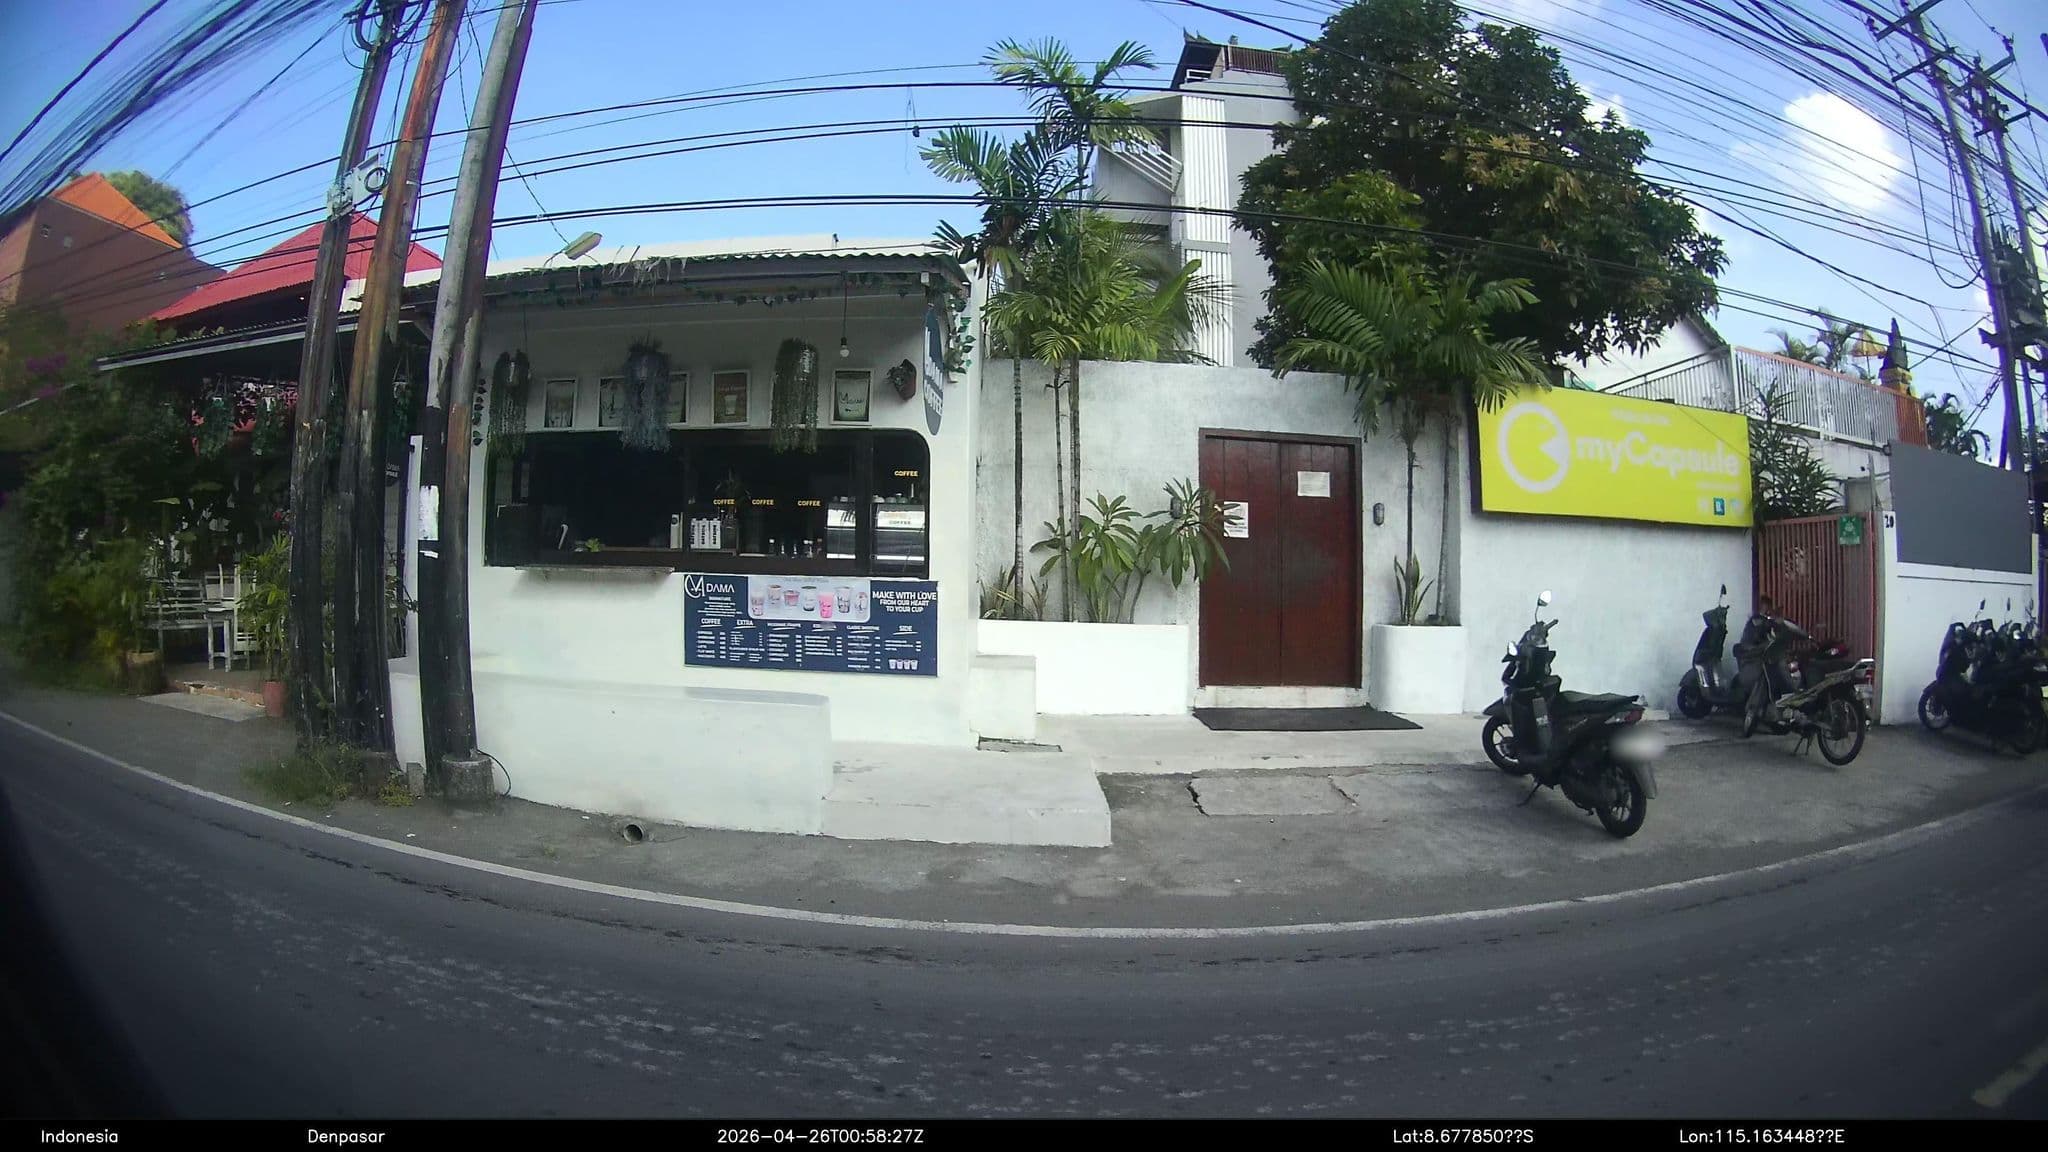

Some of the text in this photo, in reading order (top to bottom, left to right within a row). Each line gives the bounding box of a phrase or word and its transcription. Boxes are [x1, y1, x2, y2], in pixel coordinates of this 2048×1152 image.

[1575, 431, 1740, 478] myCapsule
[1883, 515, 1895, 528] 20
[706, 583, 735, 593] DAMA
[872, 591, 937, 600] MAKE WITH LOVE
